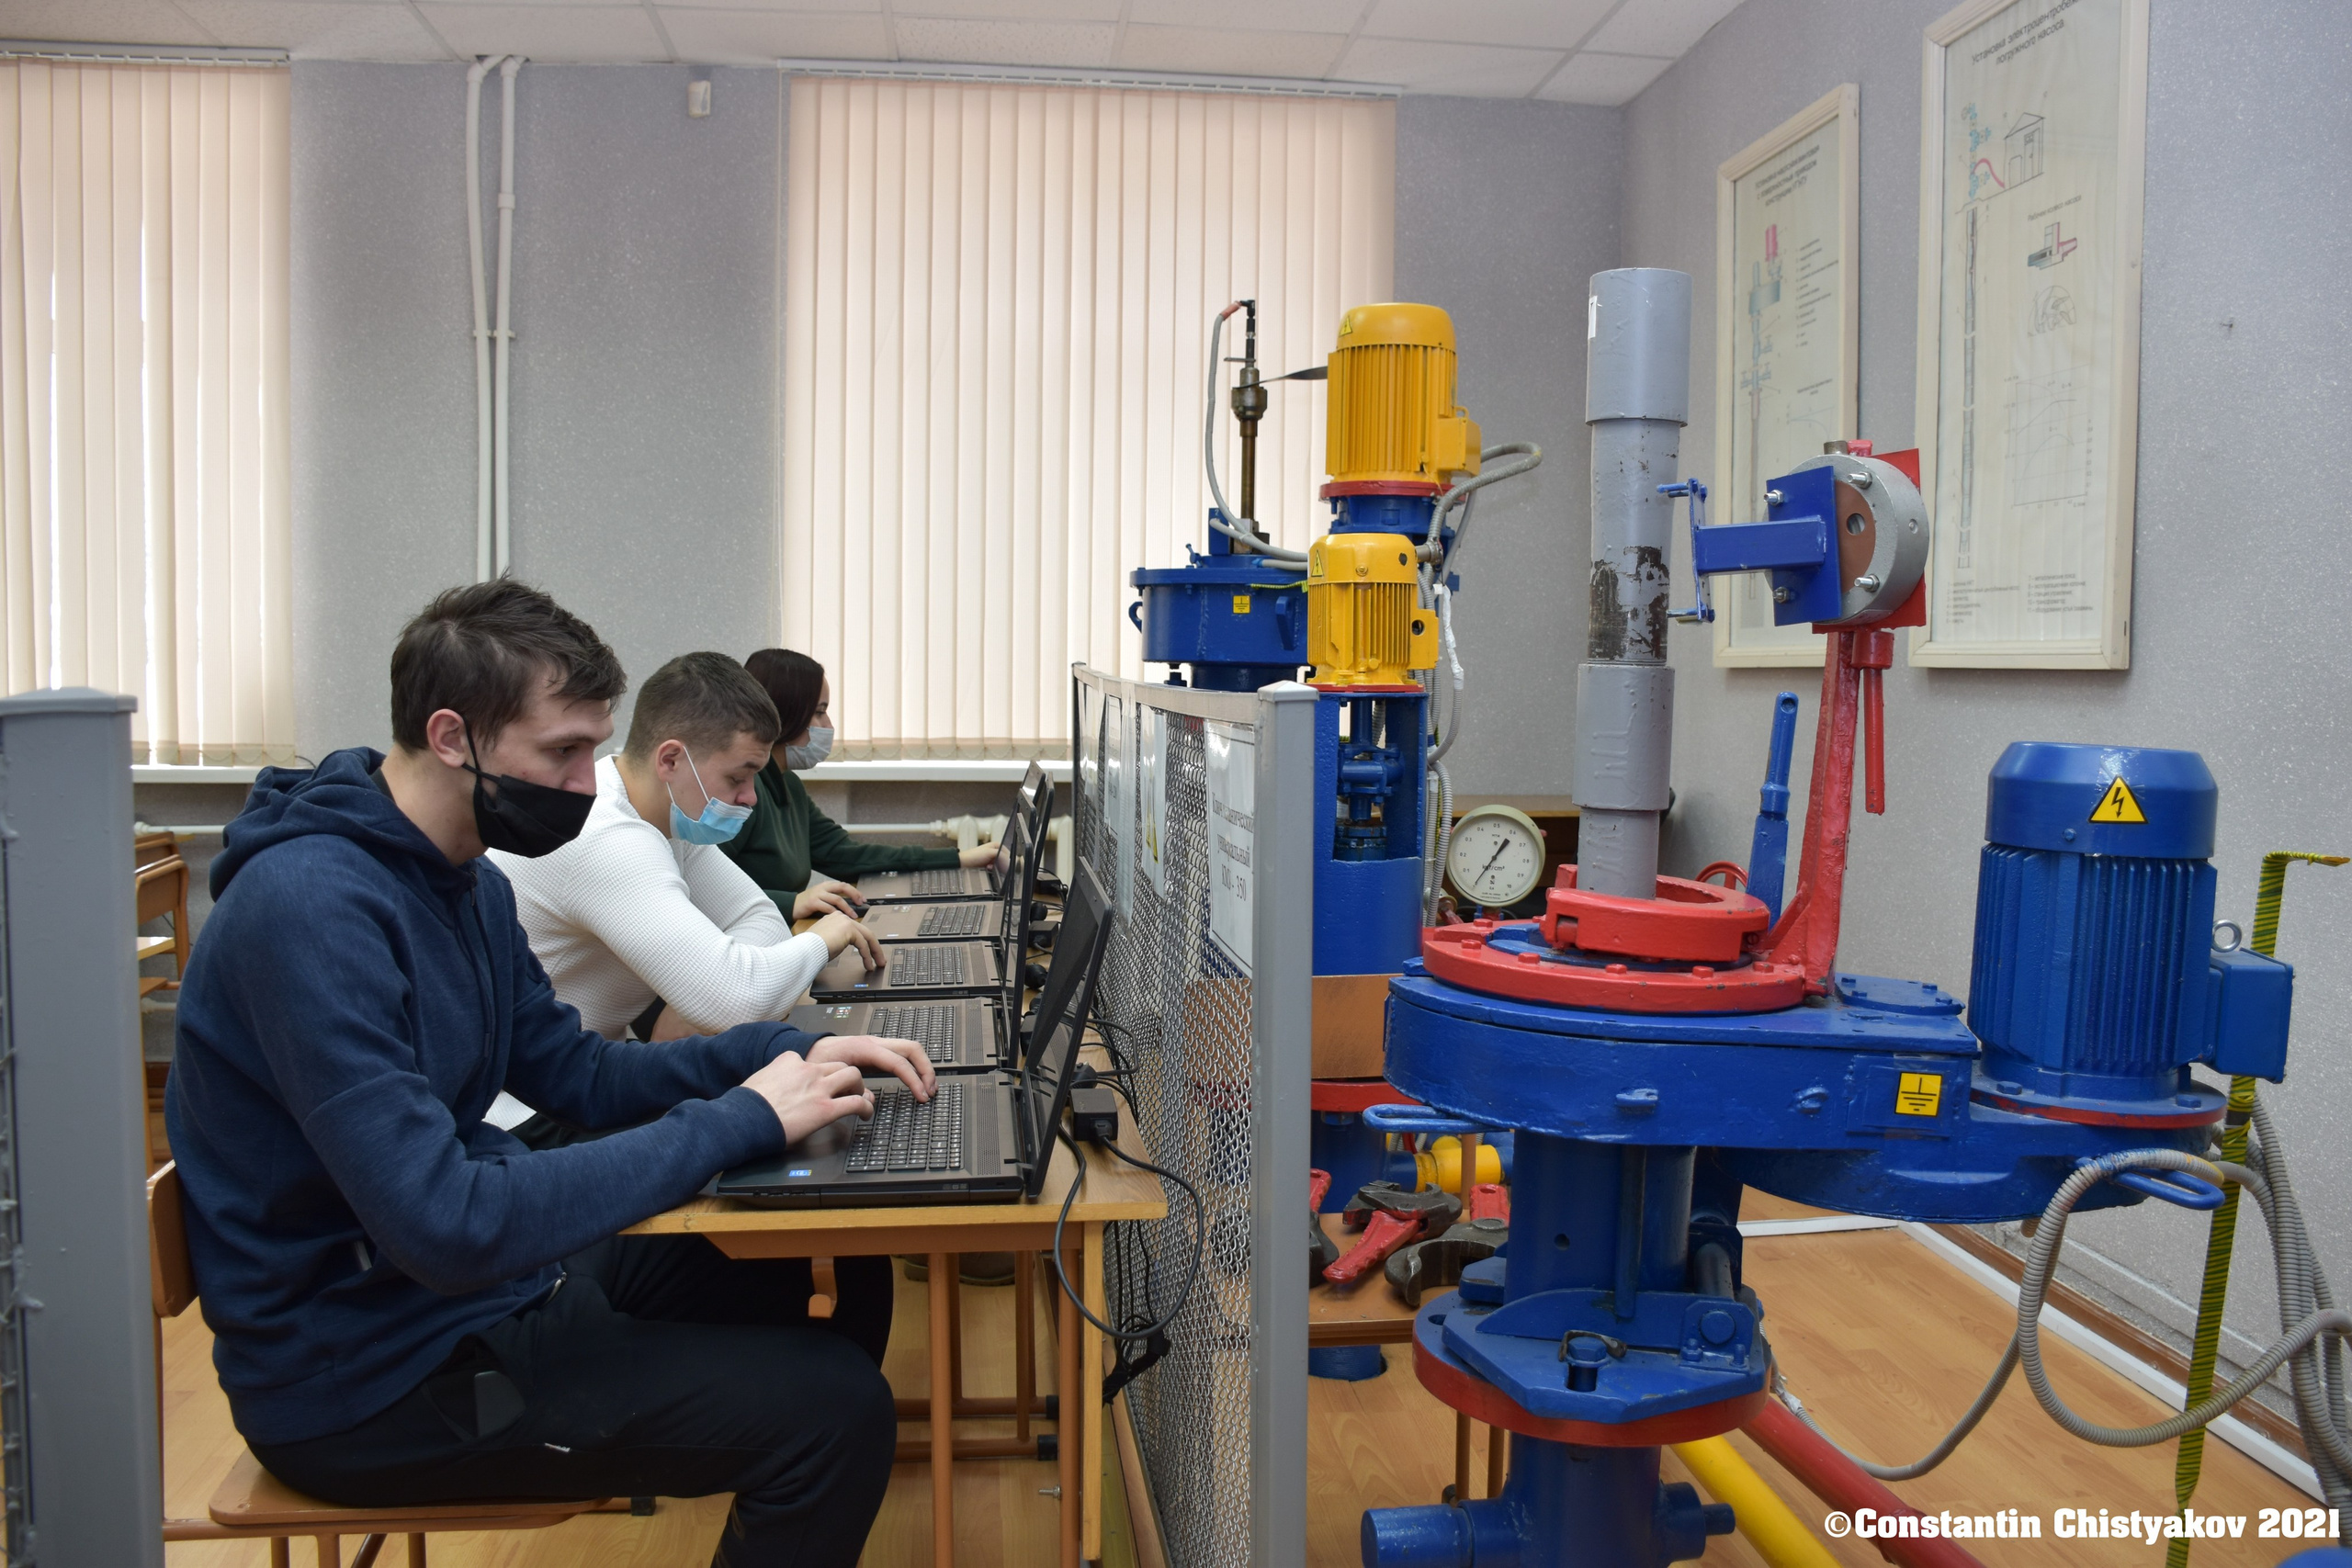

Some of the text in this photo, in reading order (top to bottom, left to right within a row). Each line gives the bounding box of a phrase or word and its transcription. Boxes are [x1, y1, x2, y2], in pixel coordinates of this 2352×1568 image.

[2037, 18, 2064, 41] насоса
[1972, 38, 2006, 65] Установка
[1236, 874, 1247, 901] 350
